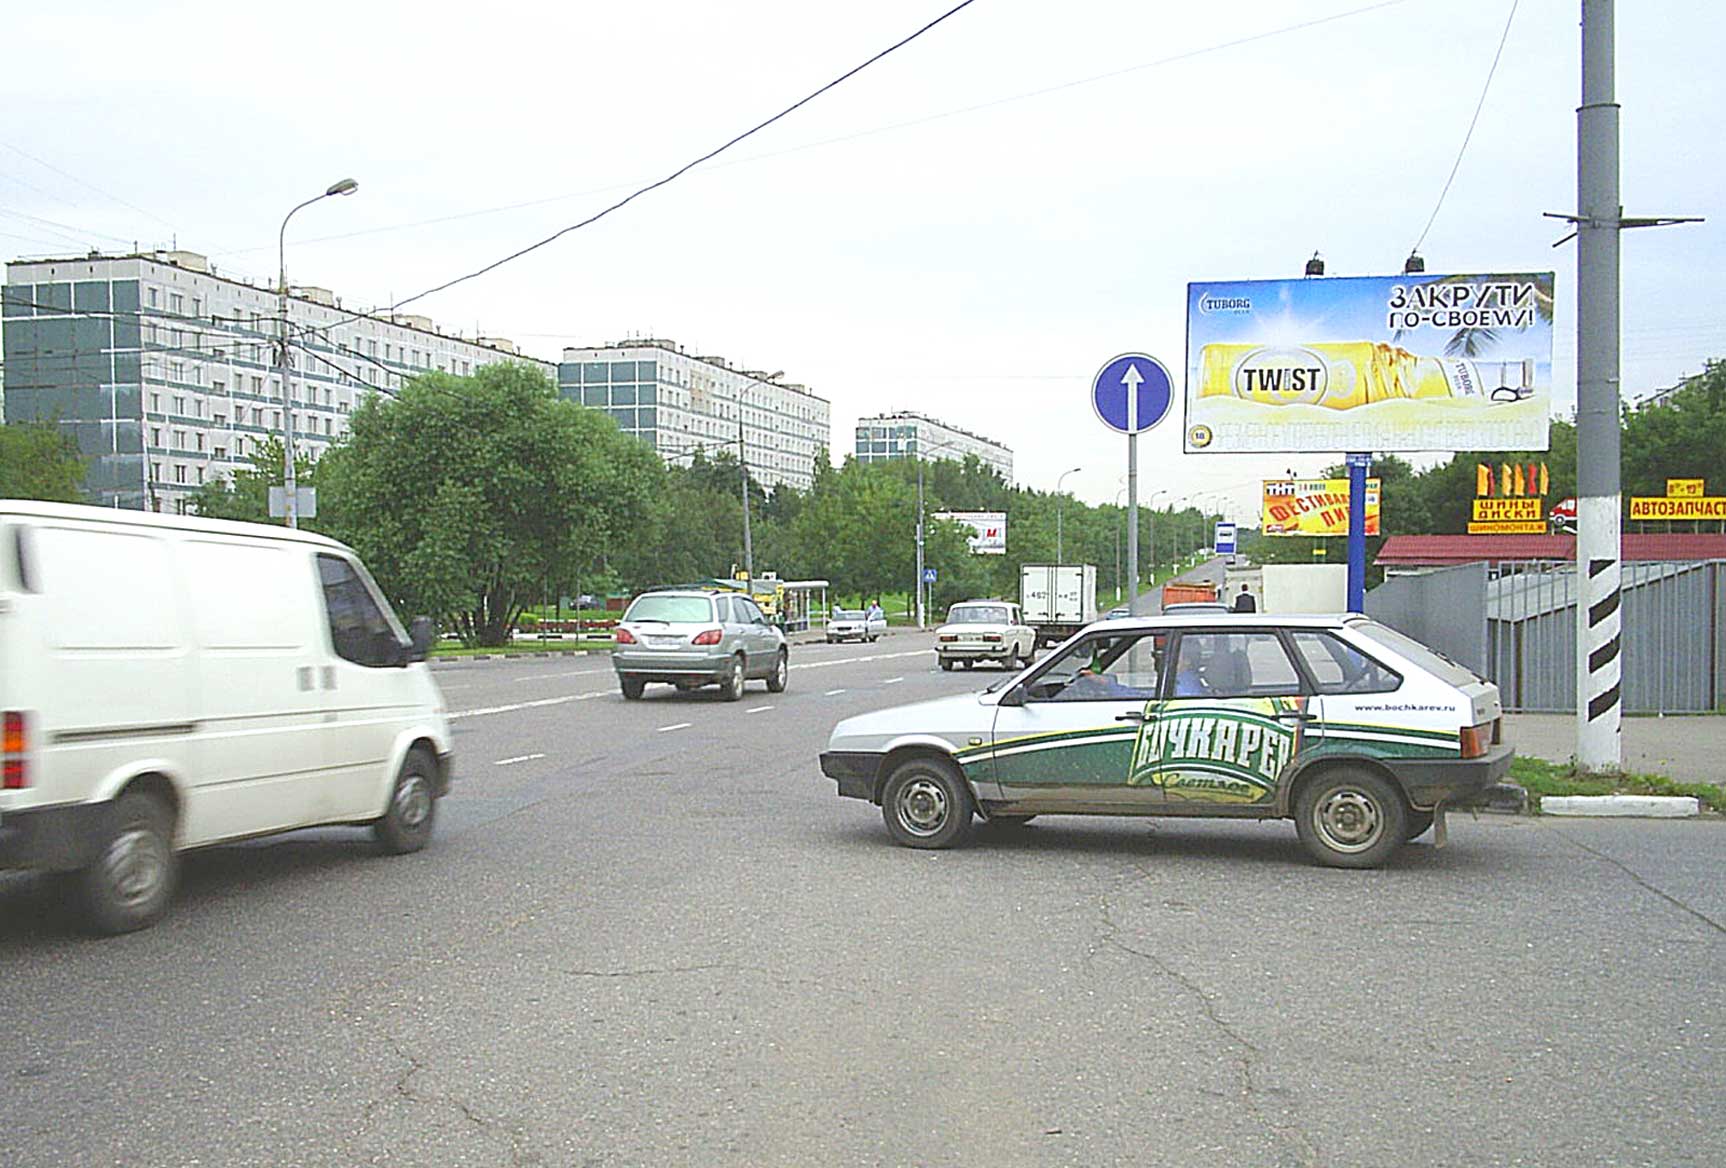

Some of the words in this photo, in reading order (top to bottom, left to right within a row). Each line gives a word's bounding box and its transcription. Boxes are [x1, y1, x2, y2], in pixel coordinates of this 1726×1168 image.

[1390, 284, 1534, 309] ЗАКРУТИ
[1206, 298, 1250, 310] TUBORG
[1389, 309, 1534, 329] ПО-СВОЕМУ!
[1243, 367, 1321, 391] TWIST
[1479, 500, 1535, 510] ШИНЫ
[1478, 509, 1536, 519] ДИСКИ
[1354, 703, 1456, 712] www.bochkarev.ru
